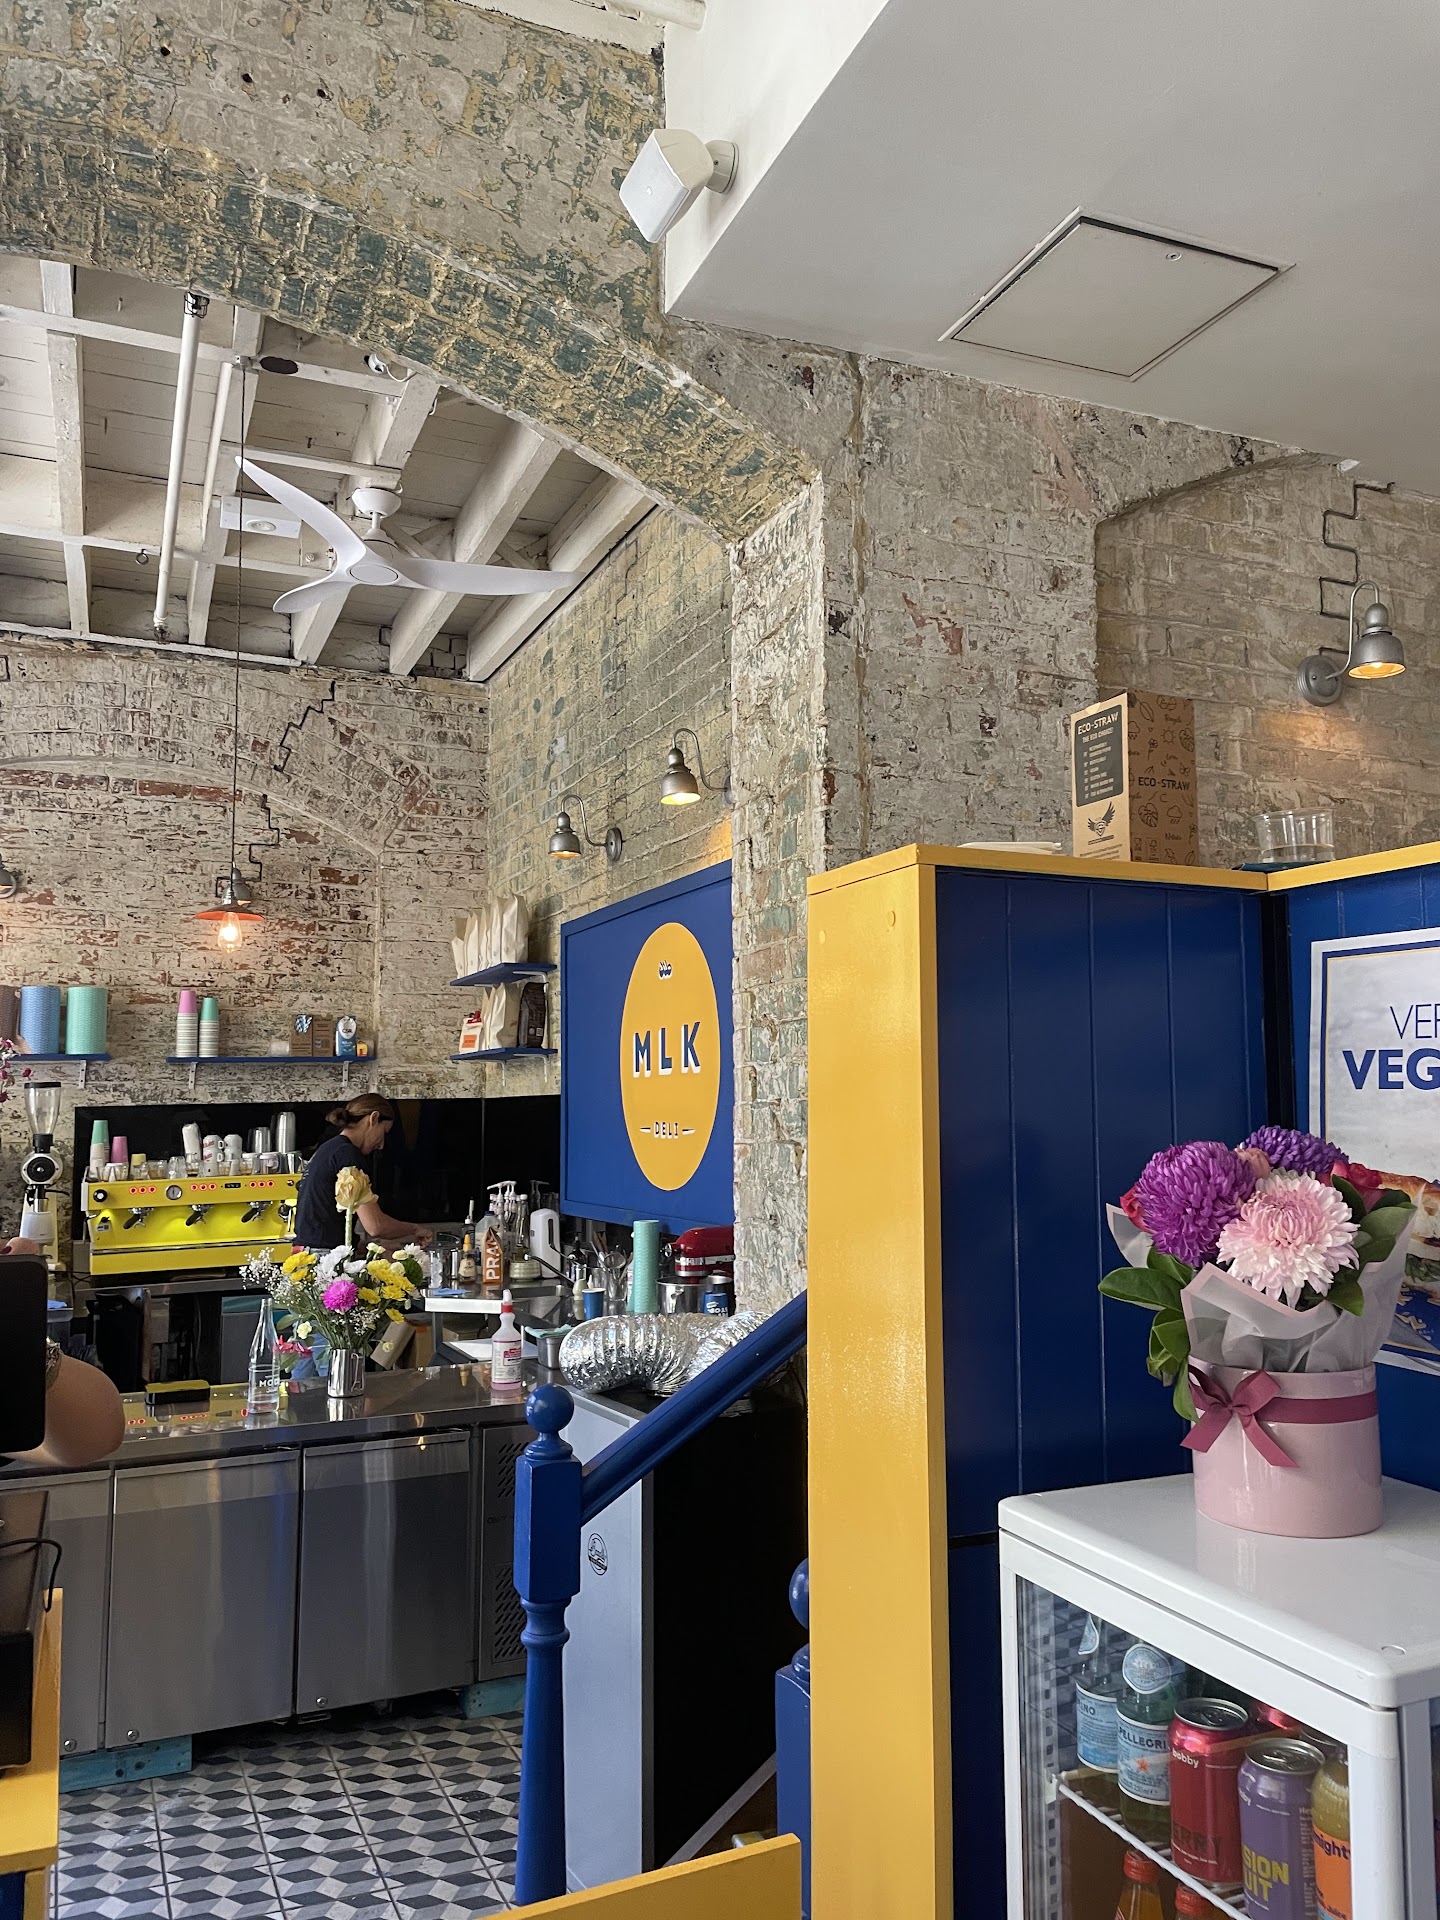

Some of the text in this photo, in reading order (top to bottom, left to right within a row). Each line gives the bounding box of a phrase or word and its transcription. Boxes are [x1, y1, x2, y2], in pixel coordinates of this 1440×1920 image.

[1078, 711, 1119, 735] ECO-STRAW
[1138, 776, 1190, 791] ECO-STRAW
[632, 1021, 701, 1078] MLK
[653, 1121, 679, 1139] DELI
[1172, 1747, 1199, 1769] bobby
